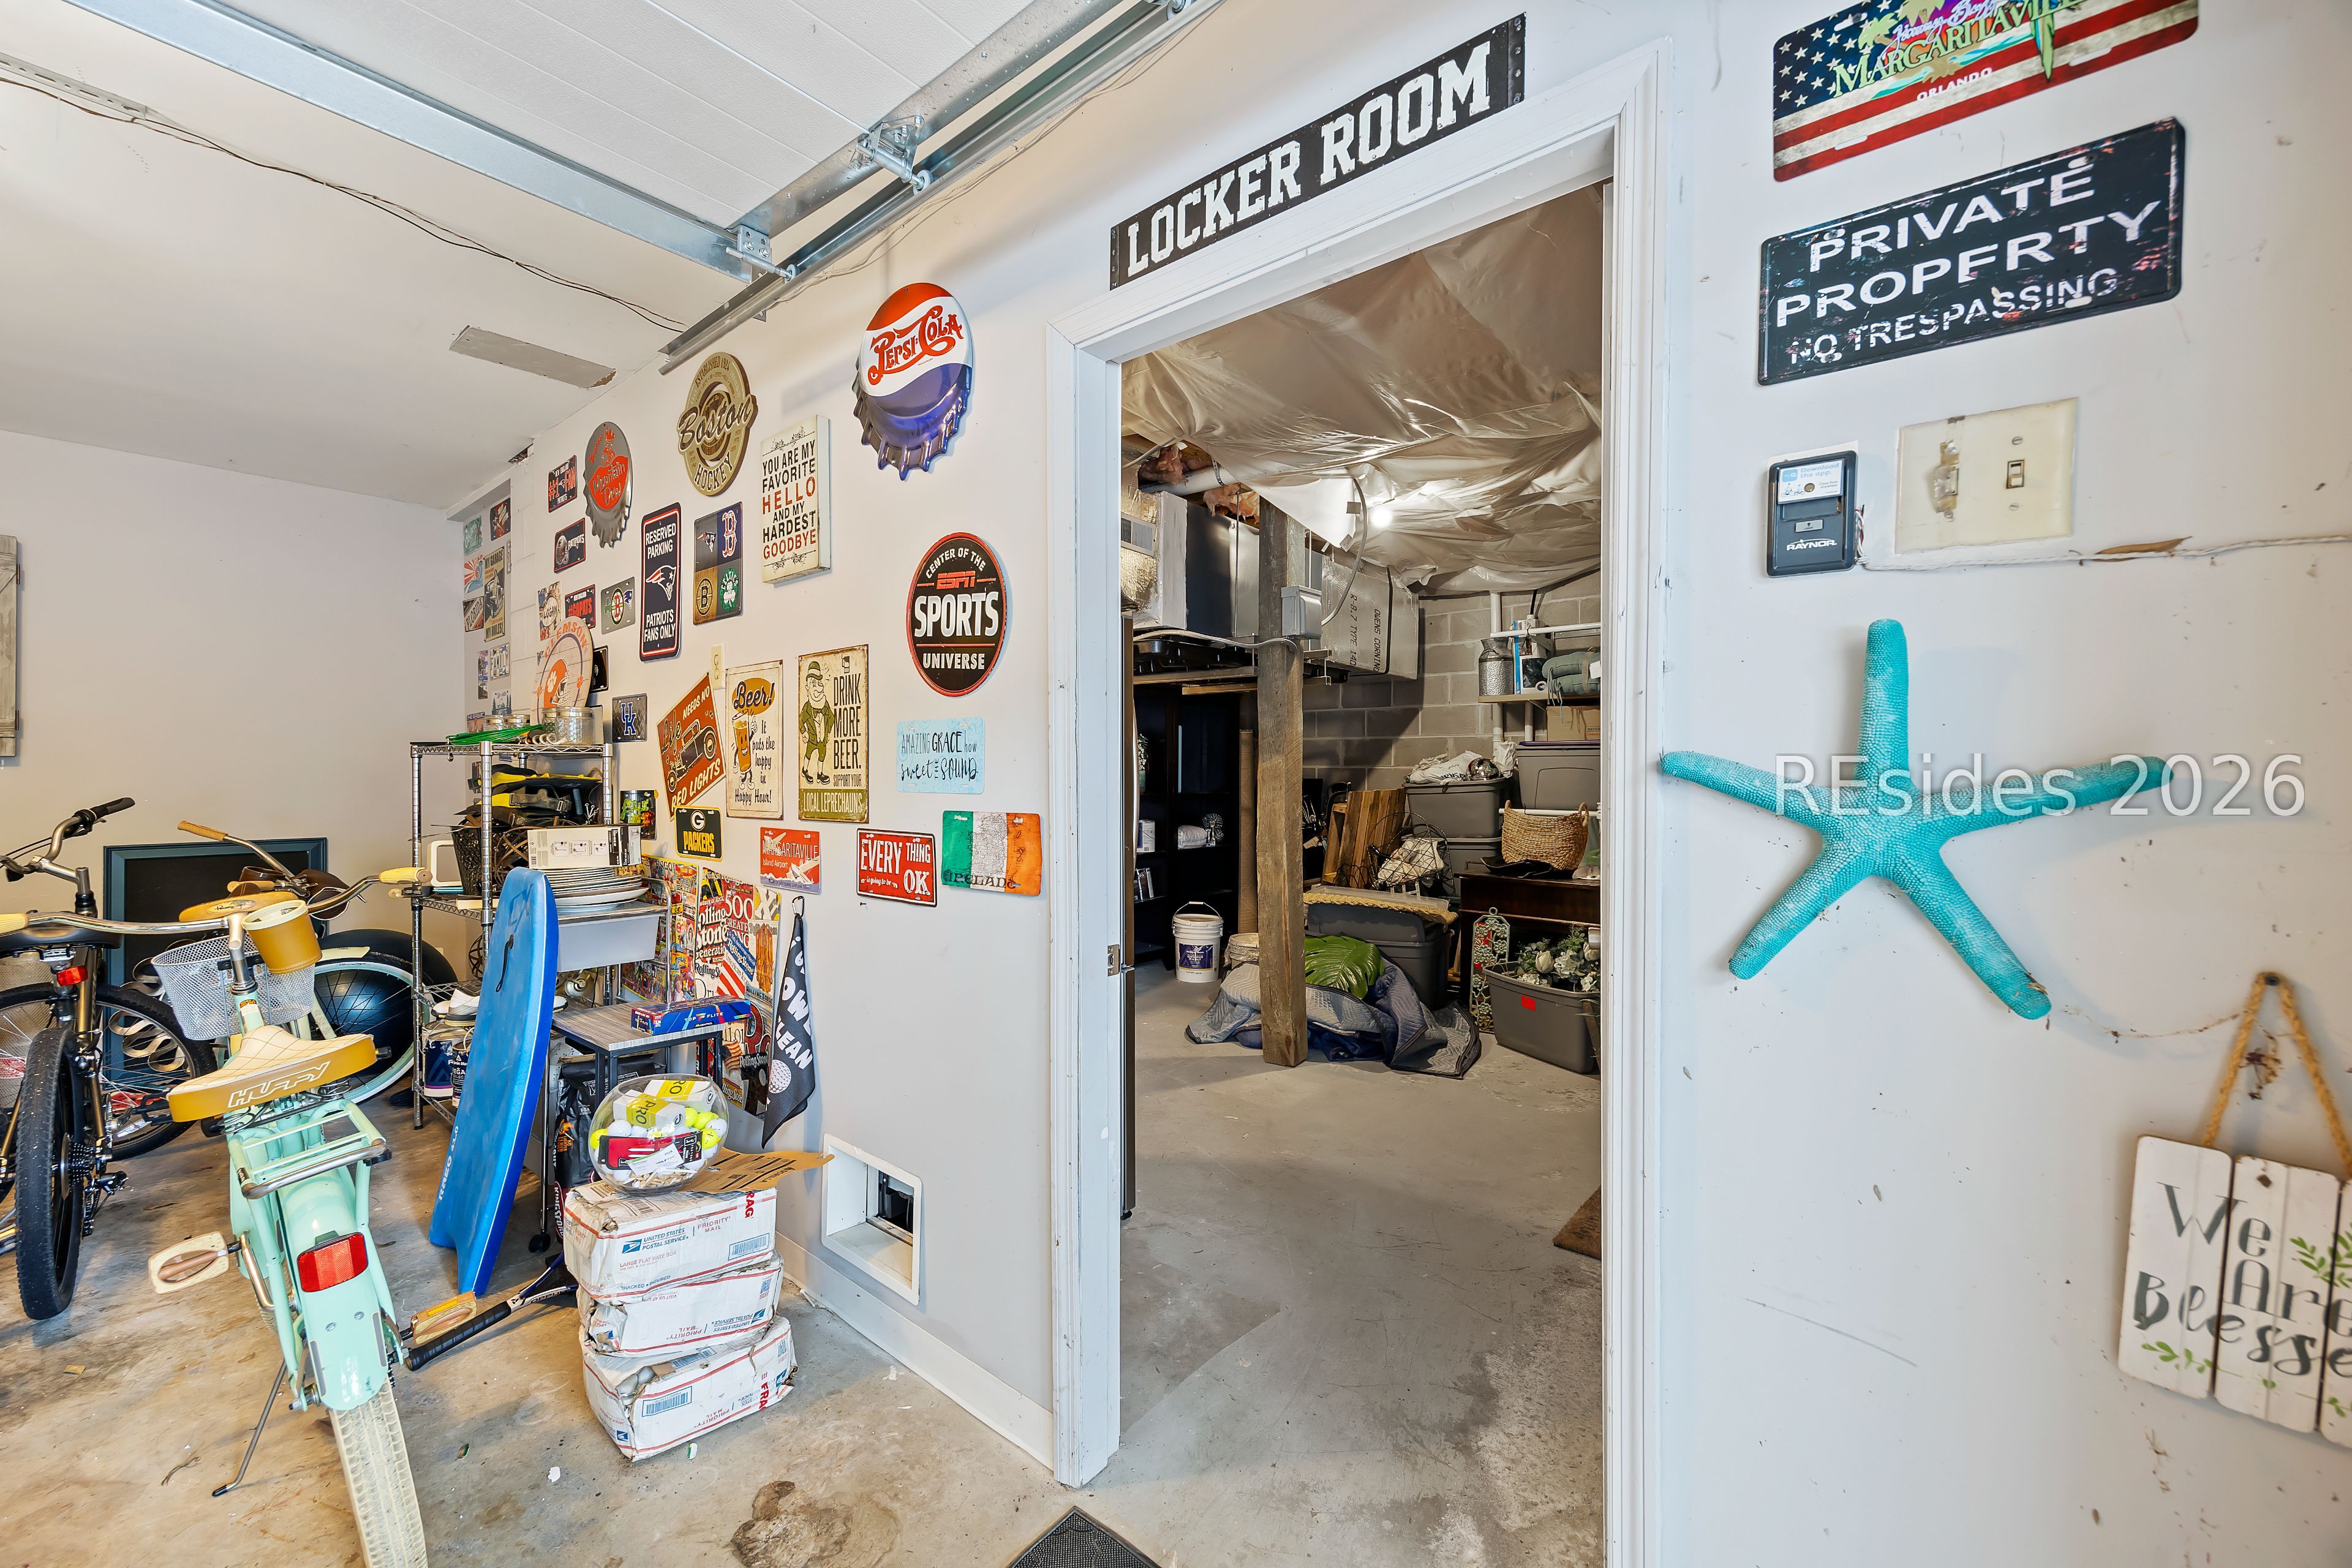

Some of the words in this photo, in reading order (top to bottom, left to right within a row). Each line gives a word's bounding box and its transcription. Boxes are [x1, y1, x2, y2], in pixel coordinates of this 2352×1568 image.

[1917, 67, 1992, 102] ORLANDO
[1127, 139, 1301, 277] LOCKER
[1321, 40, 1490, 185] ROOM
[1809, 163, 2095, 273] PRIVATE
[1790, 334, 1838, 364] NO
[1847, 268, 2119, 352] TRESPASSING
[695, 356, 720, 388] ESTABLISHED
[678, 394, 753, 450] Boston
[694, 451, 733, 491] HOCKEY
[763, 456, 779, 476] YOU
[782, 447, 799, 469] ARE
[801, 440, 815, 460] MY
[1801, 462, 1839, 473] Download
[565, 466, 576, 492] FAN
[592, 461, 625, 496] Mountain
[763, 458, 815, 493] FAVORITE
[601, 483, 622, 505] Dew
[763, 476, 815, 514] HELLO
[773, 507, 790, 523] AND
[793, 501, 805, 516] MY
[646, 523, 676, 546] RESERVED
[763, 510, 816, 543] HARDEST
[647, 539, 673, 559] PARKING
[763, 529, 816, 560] GOODBYE
[925, 548, 956, 579] CENTER
[957, 548, 970, 558] OF
[971, 551, 986, 571] THE
[722, 571, 738, 590] CELTICS
[937, 571, 976, 590] ESPN
[466, 598, 483, 630] FLORIDA
[568, 598, 592, 617] #GOPATS
[646, 609, 674, 628] PATRIOTS
[914, 592, 999, 637] SPORTS
[544, 621, 587, 658] CLEMSON
[644, 627, 658, 642] FANS
[660, 623, 676, 639] ONLY
[922, 653, 985, 669] UNIVERSE
[682, 697, 700, 720] NEEDS
[701, 685, 710, 703] NO
[733, 680, 775, 709] Beer!
[834, 673, 861, 706] DRINK
[621, 702, 636, 735] UK
[761, 720, 766, 734] It
[834, 706, 861, 737] MORE
[662, 709, 682, 755] Life
[752, 739, 764, 753] puts
[766, 736, 775, 750] the
[902, 733, 930, 754] AMAZING
[932, 731, 962, 753] GRACE
[965, 730, 977, 752] how
[755, 755, 772, 770] happy
[834, 739, 862, 769] BEER.
[760, 772, 766, 784] in
[833, 774, 850, 786] SUPPORT
[851, 774, 862, 786] YOUR
[902, 759, 933, 781] sweet
[671, 786, 687, 812] RED
[690, 758, 720, 796] LIGHTS
[735, 789, 752, 806] Happy
[754, 788, 772, 803] Hour!
[804, 792, 820, 812] LOCAL
[821, 792, 862, 813] LEPRECHAUNS
[683, 831, 715, 854] PACKERS
[762, 840, 818, 861] MARGARITAVILLE
[774, 860, 788, 869] Airport
[861, 839, 903, 874] EVERY
[906, 842, 930, 864] THING
[870, 877, 881, 886] going
[903, 869, 930, 895] OK
[699, 897, 711, 906] uture
[726, 890, 753, 920] 500
[698, 905, 726, 927] olling
[775, 1016, 813, 1070] LEAN
[227, 1061, 331, 1109] HUFFY
[635, 1101, 656, 1125] PRO
[554, 1187, 564, 1237] KINGSFORD
[2157, 1182, 2271, 1257] We
[642, 1242, 663, 1251] POSTAL
[643, 1233, 666, 1243] UNITED
[666, 1227, 685, 1237] STATES
[649, 1275, 671, 1286] INSURED
[706, 1408, 723, 1418] MAIL
